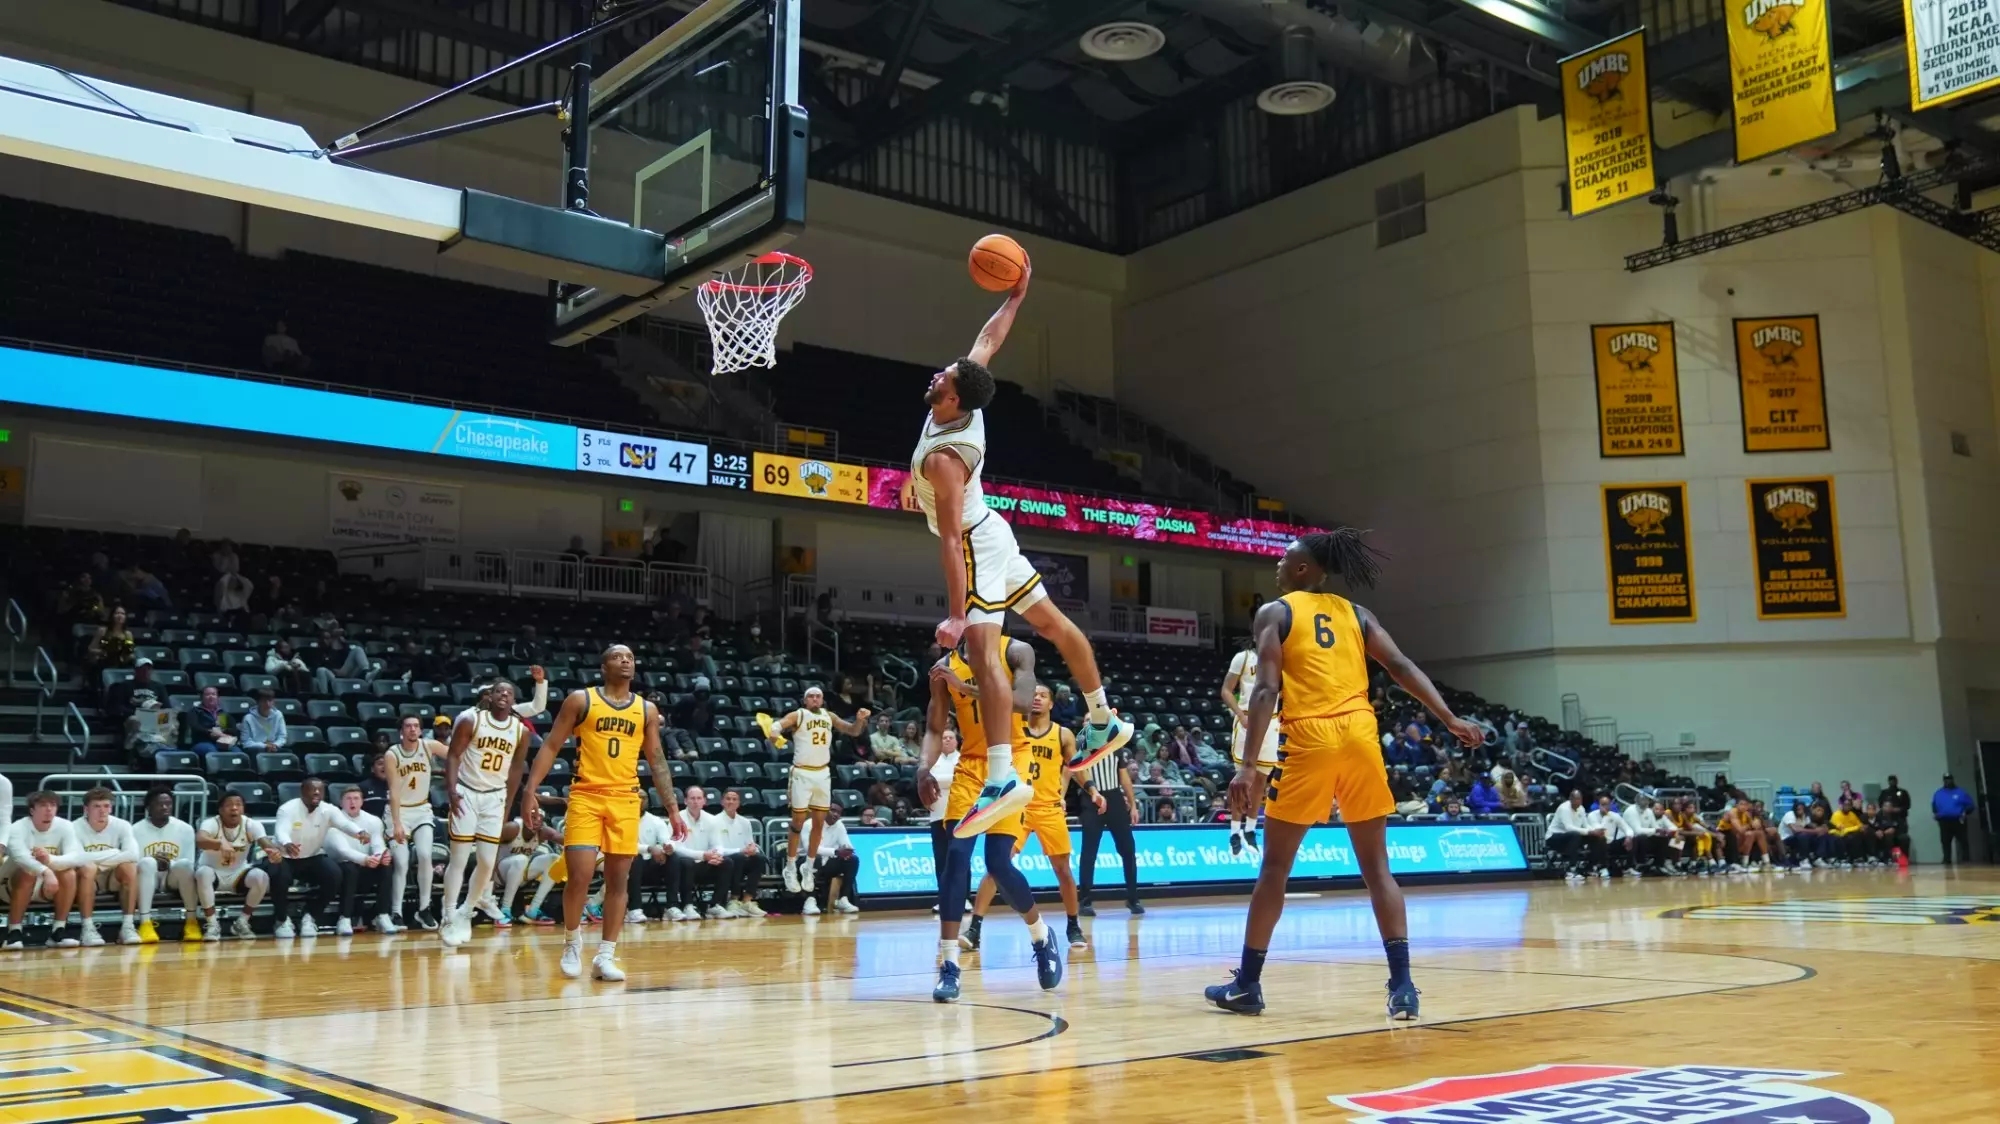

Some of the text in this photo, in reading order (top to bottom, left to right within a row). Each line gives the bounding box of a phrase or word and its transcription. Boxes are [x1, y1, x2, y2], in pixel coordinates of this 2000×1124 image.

[1948, 0, 1987, 20] 2018
[1948, 12, 1993, 38] NCAA
[1924, 24, 2000, 58] TOURNAME
[1923, 46, 1972, 71] SECOND
[1934, 55, 1991, 81] #16 UMBC
[1578, 53, 1628, 89] UMBC
[1743, 55, 1819, 87] AMERICA EAST
[1928, 65, 1998, 94] #1 VIRGINIA
[1737, 63, 1825, 100] REGULAR SEASON
[1752, 81, 1812, 107] CHAMPIONS
[1740, 110, 1765, 126] 2021
[1574, 134, 1646, 166] AMERICA EAST
[1574, 145, 1647, 177] CONFERENCE
[1575, 157, 1648, 190] CHAMPIONS
[1609, 332, 1659, 354] UMBC
[1753, 326, 1803, 348] UMBC
[1606, 405, 1673, 415] AMERICA EAST
[1606, 414, 1674, 425] CONFERENCE
[1769, 409, 1800, 423] CIT
[582, 433, 612, 447] 5 FLS
[1606, 424, 1675, 436] CHAMPIONS
[455, 424, 549, 458] Chesapeake
[1611, 439, 1645, 450] NCAA
[582, 452, 612, 466] 3 TOL
[619, 442, 657, 471] CSU
[669, 451, 697, 474] 47
[713, 453, 748, 471] 9:25
[712, 474, 746, 489] HALF 2
[763, 463, 789, 486] 69
[799, 460, 833, 483] UMBC
[855, 471, 863, 483] 4
[855, 488, 864, 501] 2
[1620, 493, 1670, 516] UMBC
[1767, 487, 1817, 510] UMBC
[357, 507, 435, 525] SHERATON
[983, 494, 1067, 518] EDDY SWIMS
[1081, 507, 1141, 527] THE FRAY
[1155, 517, 1196, 534] DASHA
[1614, 541, 1680, 551] VOLLEYBALL
[1761, 537, 1828, 546] VOLLEYBALL
[1616, 573, 1683, 585] NORTHEAST
[1789, 567, 1827, 579] SOUTH
[1616, 584, 1686, 596] CONFERENCE
[1763, 579, 1835, 591] CONFERENCE
[1616, 595, 1688, 608] CHAMPIONS
[1764, 591, 1836, 604] CHAMPIONS
[1149, 616, 1196, 637] ESPN
[1313, 613, 1336, 648] 6
[596, 716, 636, 737] COPPIN
[477, 736, 513, 754] UMBC
[608, 737, 620, 759] 0
[812, 731, 827, 745] 24
[481, 752, 504, 772] 20
[1032, 745, 1053, 760] PPIN
[408, 776, 416, 790] 4
[144, 842, 180, 860] UMBC
[1166, 846, 1197, 867] for
[1297, 843, 1350, 866] Safety
[1438, 838, 1508, 866] Chesapeake
